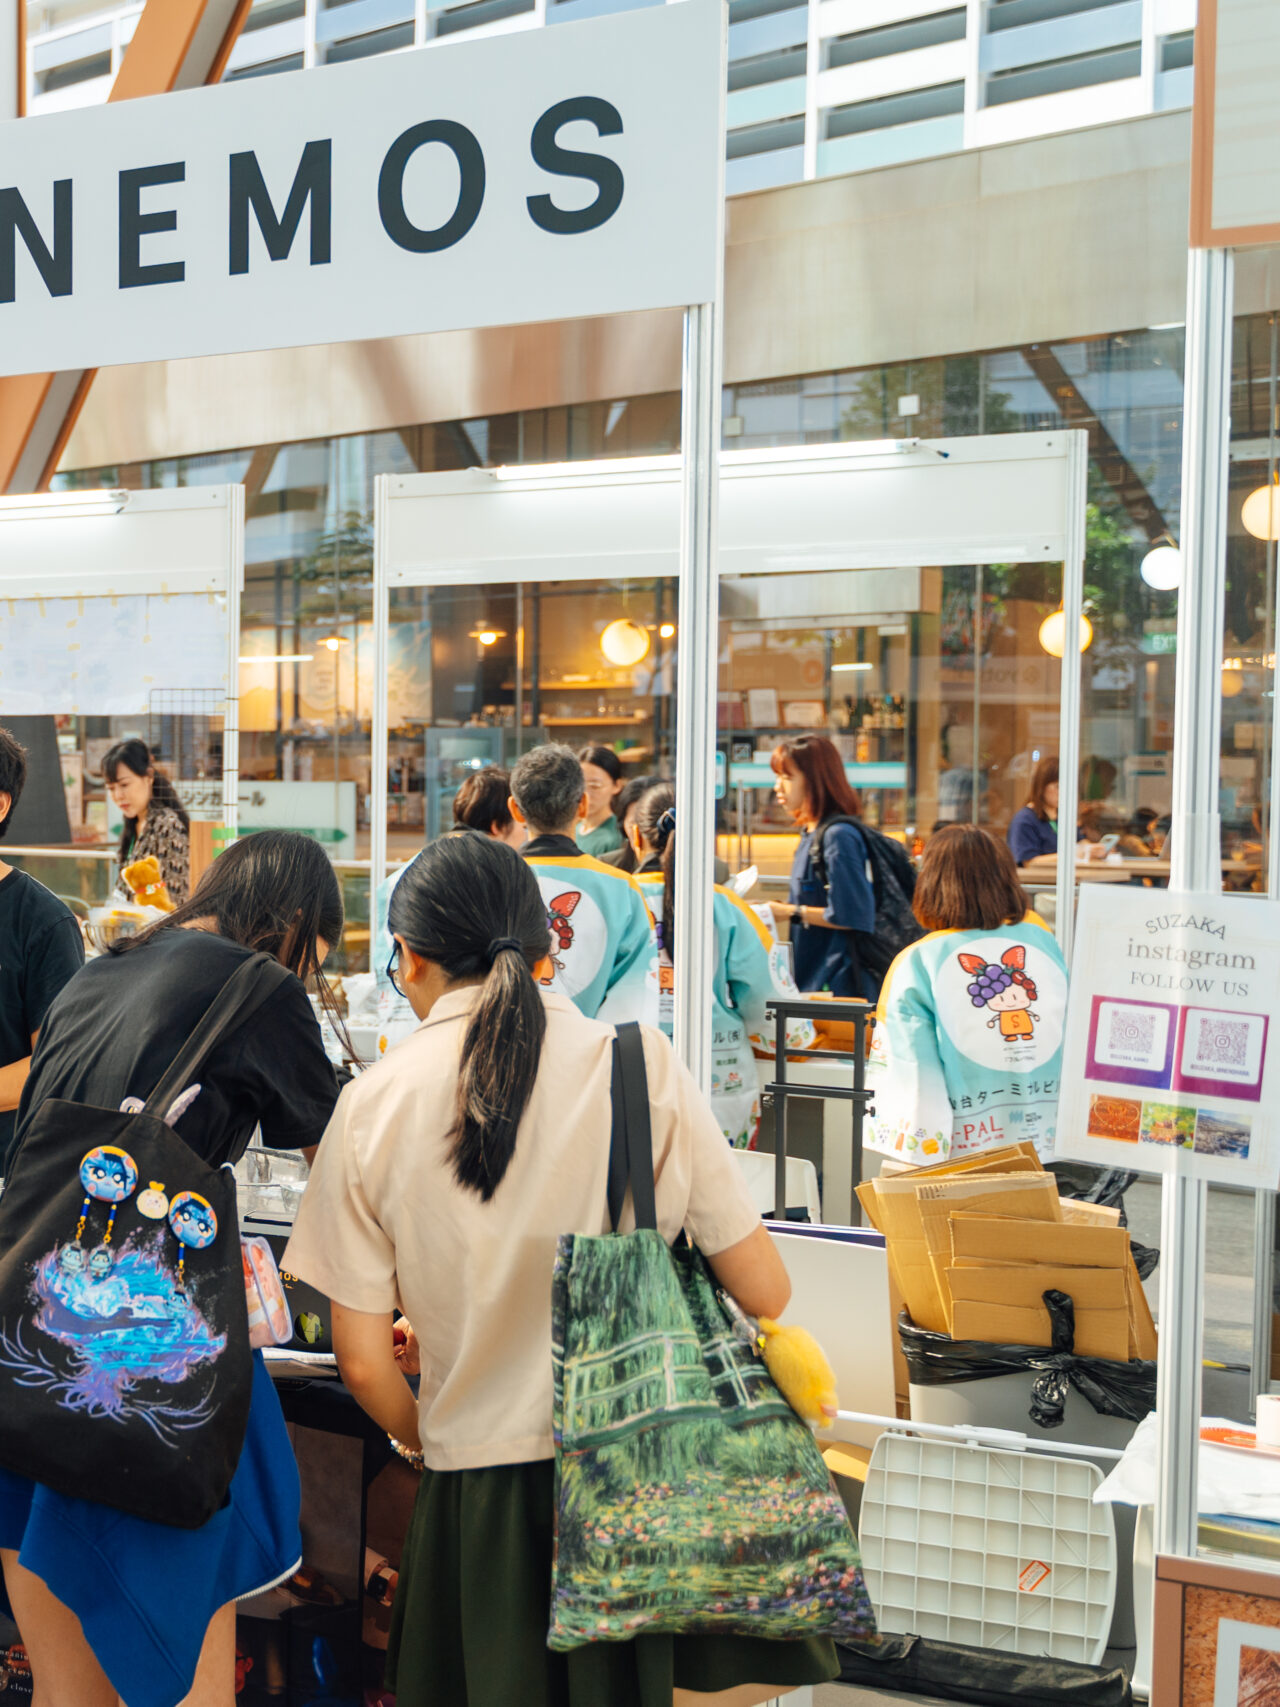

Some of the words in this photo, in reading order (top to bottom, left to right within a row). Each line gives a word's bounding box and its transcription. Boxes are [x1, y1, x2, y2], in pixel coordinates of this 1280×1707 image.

[1145, 914, 1227, 940] SUZAKA
[1127, 938, 1256, 970] instagram
[1129, 971, 1214, 993] FOLLOW
[1223, 982, 1249, 997] US
[952, 1115, 1004, 1141] -PAL
